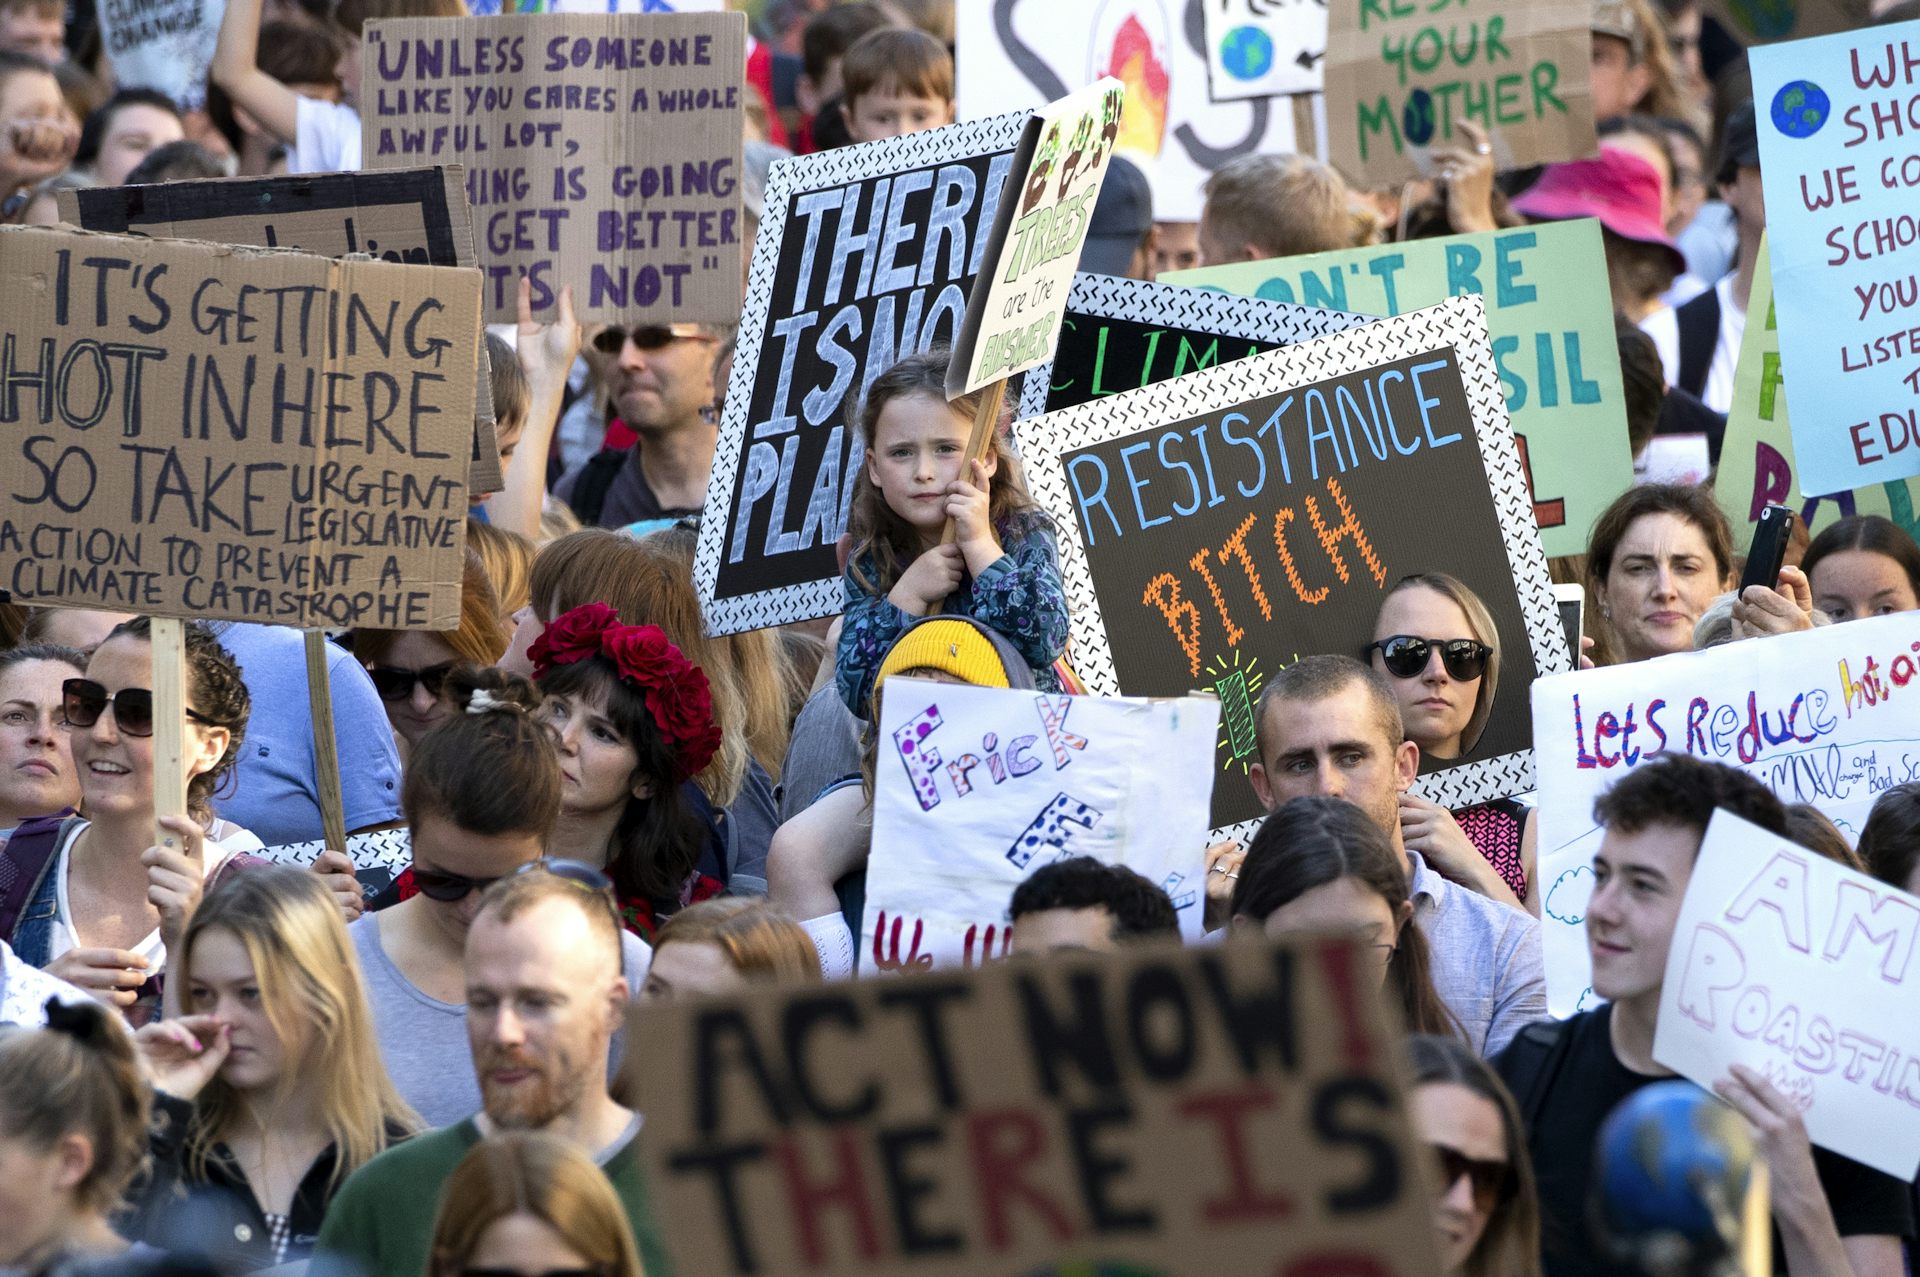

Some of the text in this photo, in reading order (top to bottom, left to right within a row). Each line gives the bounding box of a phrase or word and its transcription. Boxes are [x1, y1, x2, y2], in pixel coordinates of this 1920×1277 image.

[368, 30, 712, 81] "UNLESS SOMEONE
[1381, 15, 1511, 86] YOUR
[378, 84, 738, 116] LIKE YOU CARES A WHOLE
[1356, 60, 1568, 161] MOTHER
[377, 122, 579, 157] AWFUL LOT,
[465, 158, 737, 206] HING IS GOING
[1800, 154, 1920, 212] WE GO
[487, 208, 740, 255] GET BETTER.
[1004, 184, 1096, 283] TREES
[1825, 213, 1920, 266] SCHO
[488, 260, 555, 312] T'S
[1002, 276, 1055, 320] are the
[1445, 232, 1537, 308] BE
[1854, 275, 1919, 321] YOU
[56, 248, 453, 368] IT'S GETTING
[753, 304, 862, 438] IS
[974, 310, 1056, 384] ANSWER
[1050, 320, 1257, 395] CLIM
[1492, 331, 1602, 413] SIL
[0, 332, 452, 460] HOT IN HERE
[11, 435, 463, 538] SO TAKE URGENT
[1067, 359, 1463, 546] RESISTANCE
[0, 519, 402, 590] ACTION TO PREVENT A
[283, 501, 463, 549] LEGISLATIVE
[12, 556, 432, 628] CLIMATE CATASTROPHE
[1142, 475, 1388, 678] BITCH
[1686, 688, 1837, 764] Reduce
[1838, 655, 1889, 720] hot
[1852, 750, 1877, 769] and
[1868, 766, 1894, 795] Bad
[1725, 850, 1920, 984] AM
[690, 938, 1374, 1136] ACT NOW!
[665, 1072, 1402, 1277] THERE IS
